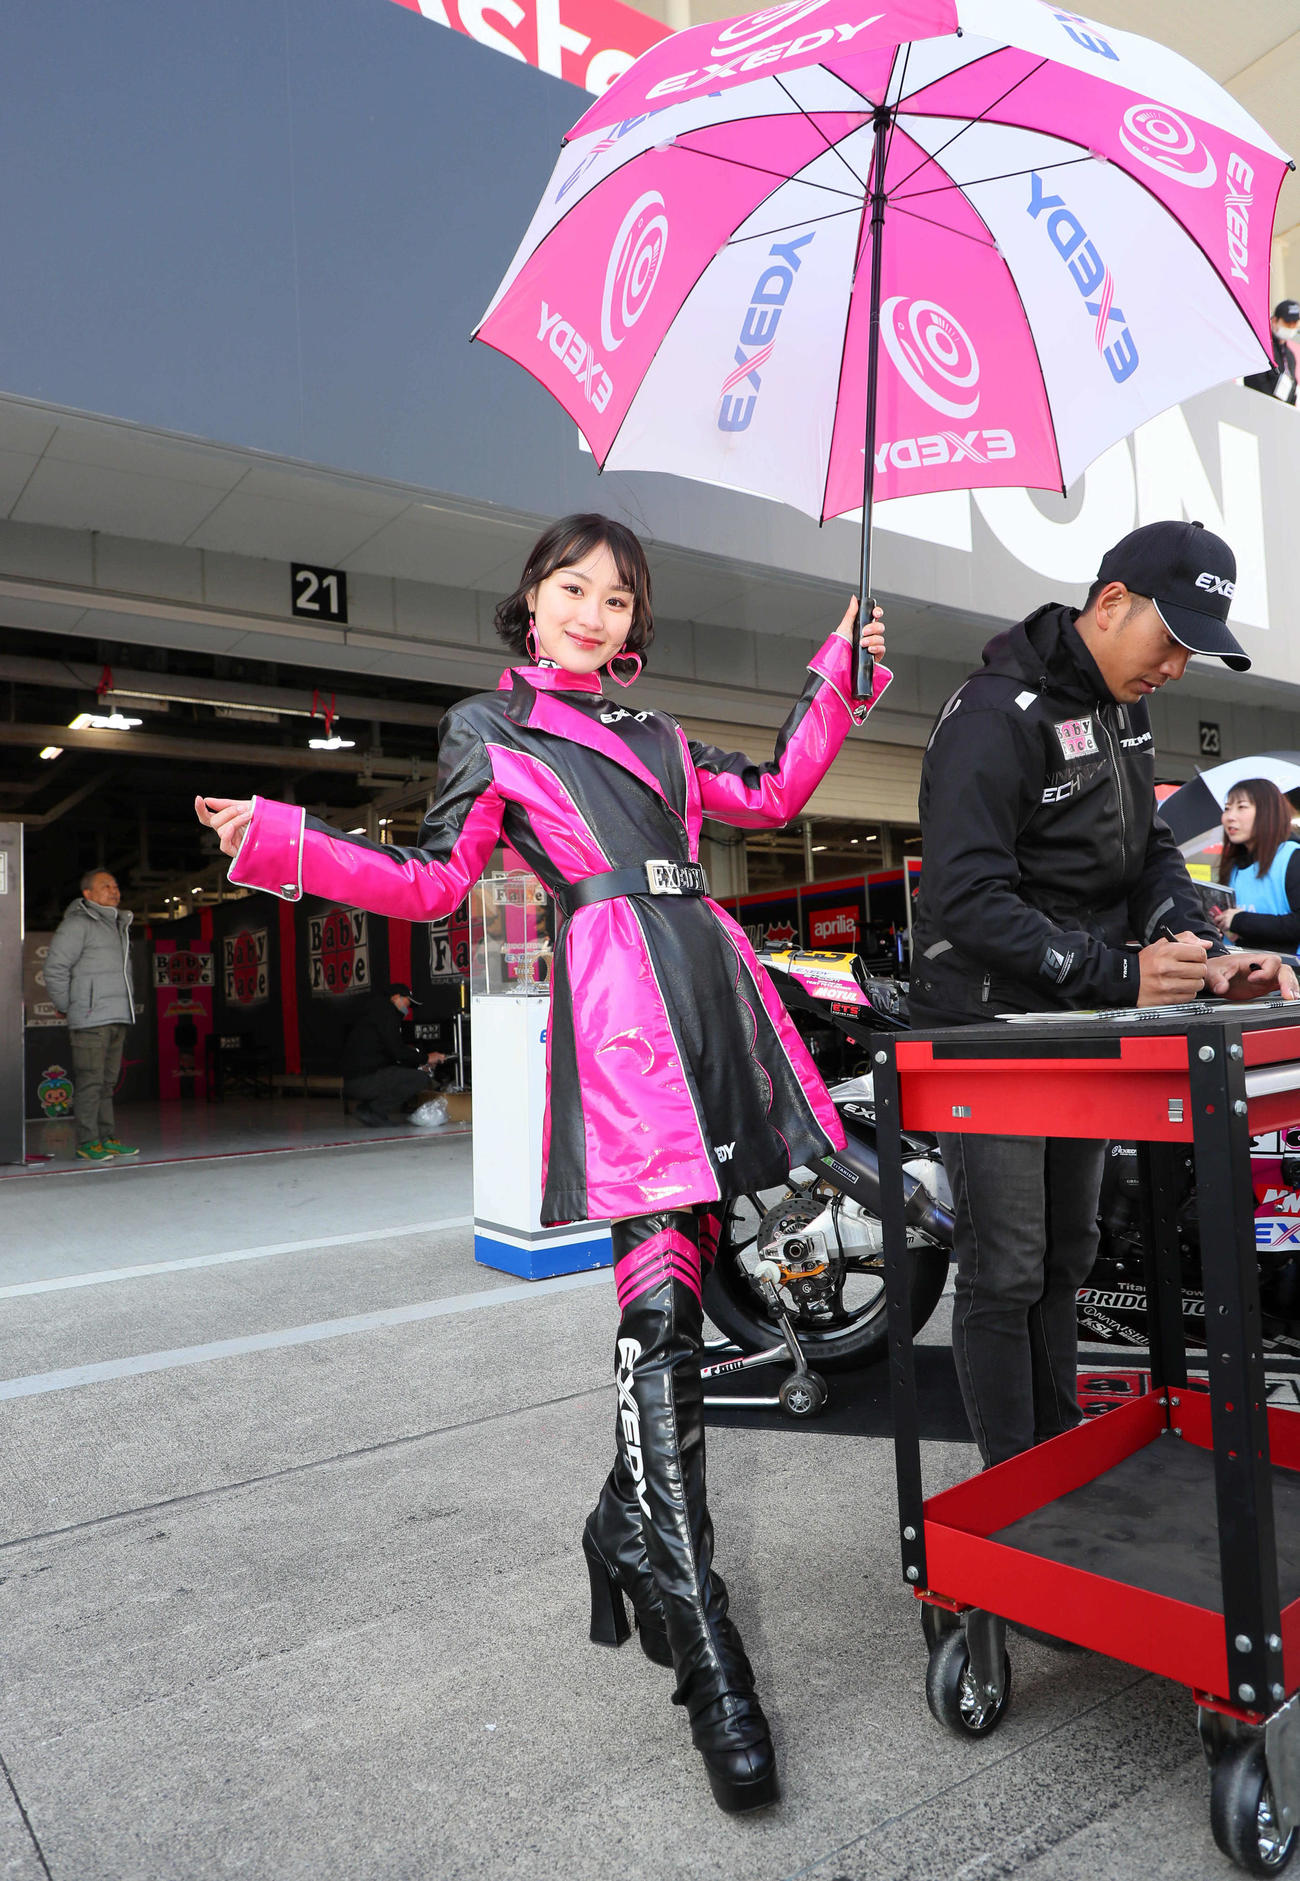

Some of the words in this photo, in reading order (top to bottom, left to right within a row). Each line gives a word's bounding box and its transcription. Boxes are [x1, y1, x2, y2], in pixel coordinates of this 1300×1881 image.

[645, 13, 887, 100] EXEDY
[296, 570, 338, 614] 21
[1201, 727, 1220, 752] 23
[310, 910, 365, 951] Baby
[814, 914, 856, 939] aprilia
[157, 956, 210, 969] Baby
[226, 935, 266, 966] Baby
[158, 970, 210, 983] Face
[227, 972, 266, 998] Face
[312, 957, 366, 988] Face
[813, 986, 858, 1002] MOTUL
[832, 1002, 859, 1015] ETS
[617, 1337, 652, 1520] EXEDY
